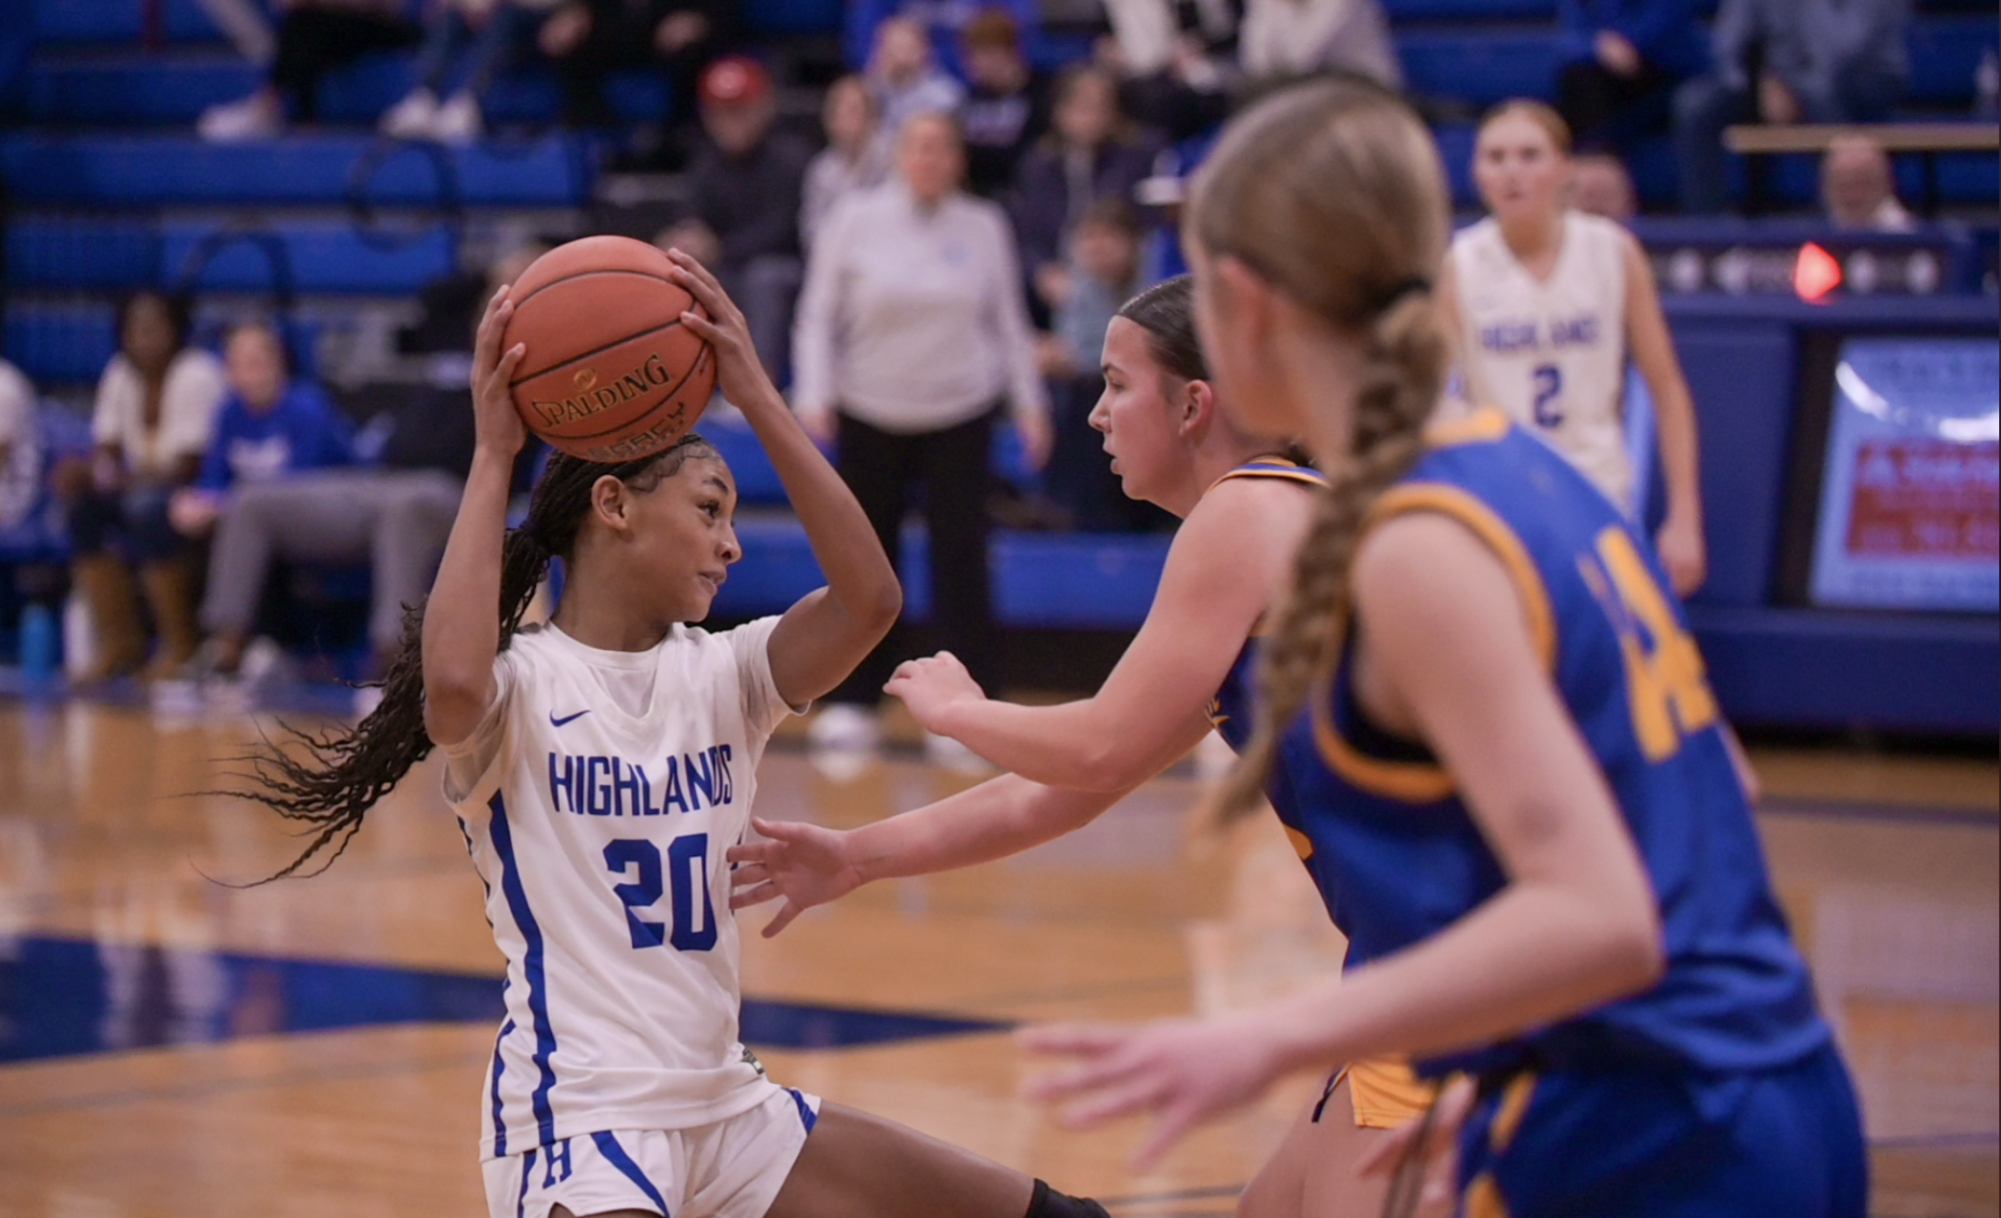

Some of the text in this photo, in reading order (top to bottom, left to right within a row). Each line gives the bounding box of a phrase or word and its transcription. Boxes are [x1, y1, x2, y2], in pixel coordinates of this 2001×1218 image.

[532, 354, 671, 427] SPALDING
[1534, 364, 1565, 429] 2
[549, 743, 733, 817] HIGHLANDS
[602, 832, 718, 952] 20
[543, 1138, 572, 1190] H
